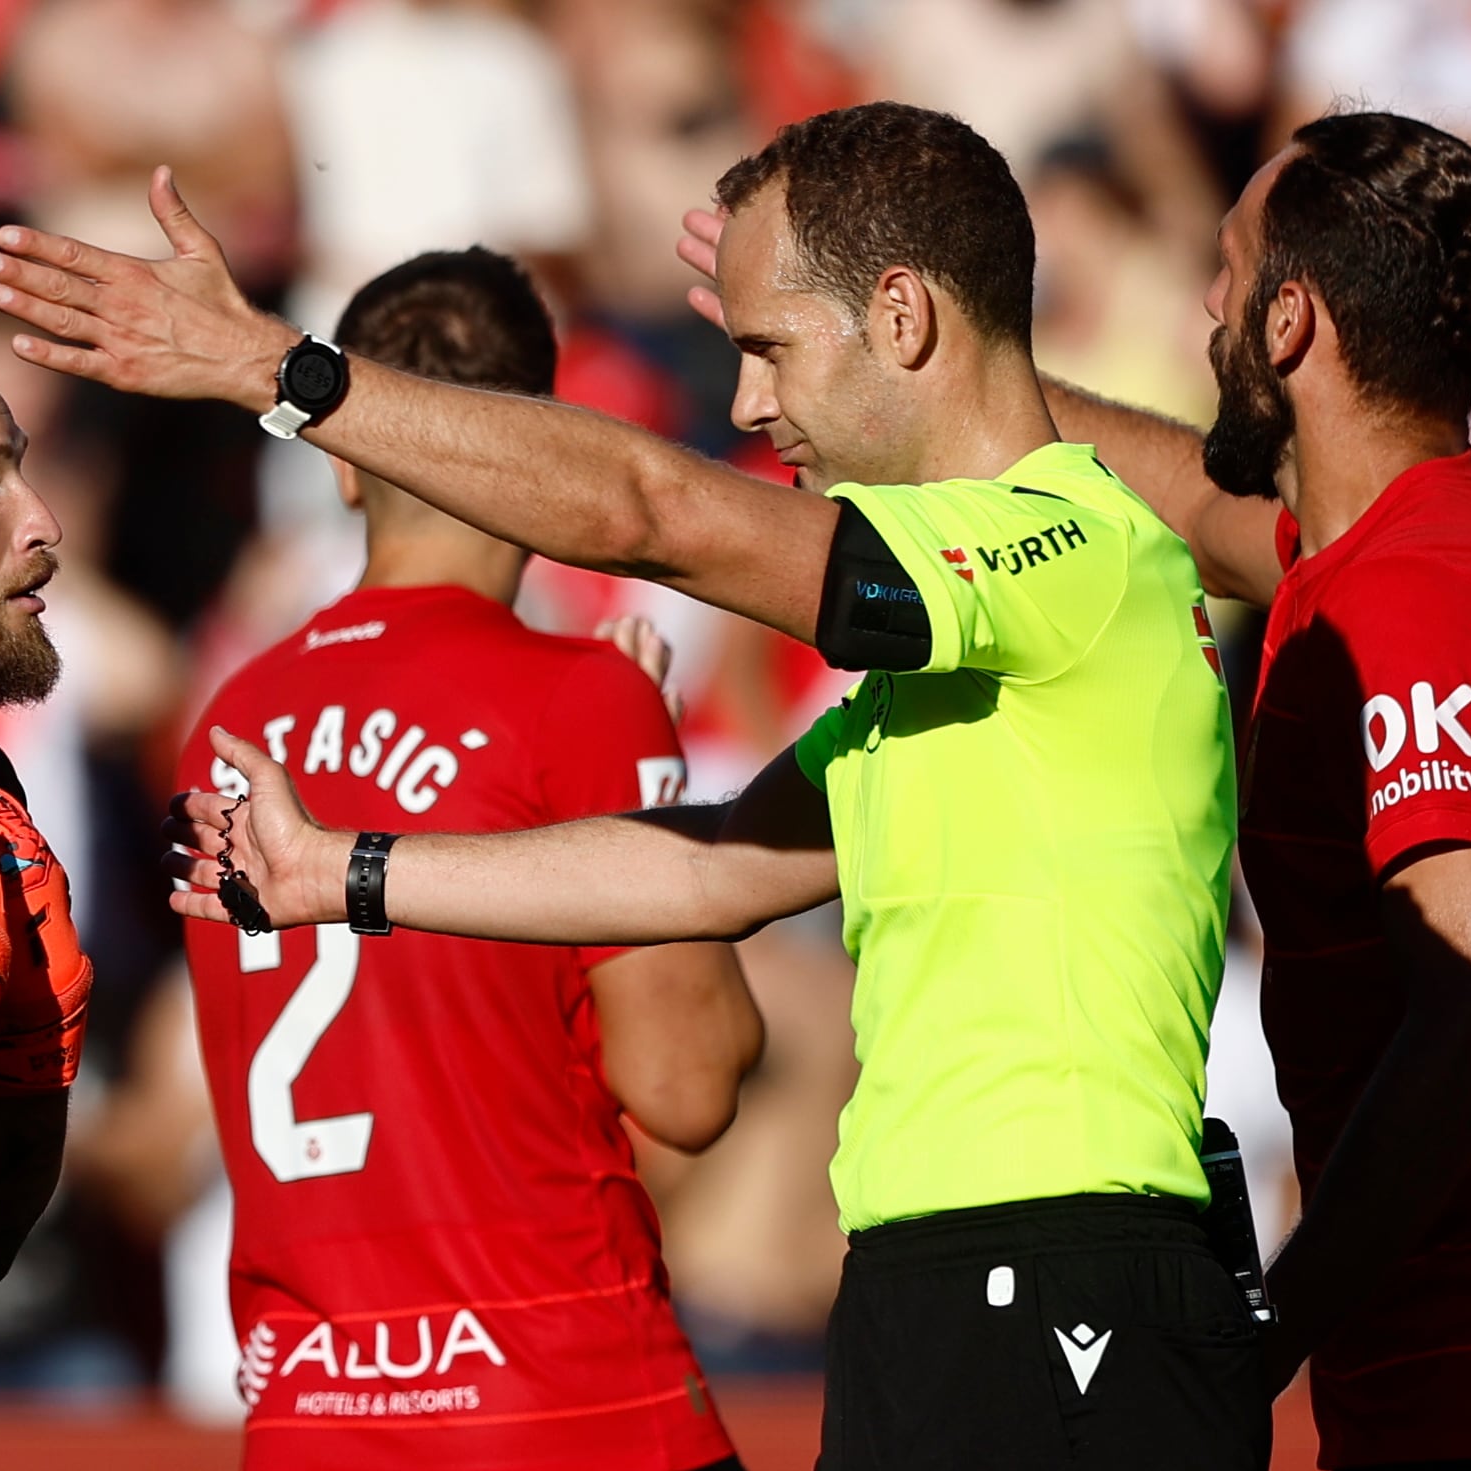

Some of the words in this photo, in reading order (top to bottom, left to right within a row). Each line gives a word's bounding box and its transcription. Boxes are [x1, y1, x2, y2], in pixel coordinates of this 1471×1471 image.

[237, 924, 375, 1184] 2
[280, 1308, 507, 1379] ALUA
[295, 1391, 370, 1416] HOTELS
[388, 1384, 480, 1415] RESORTS
